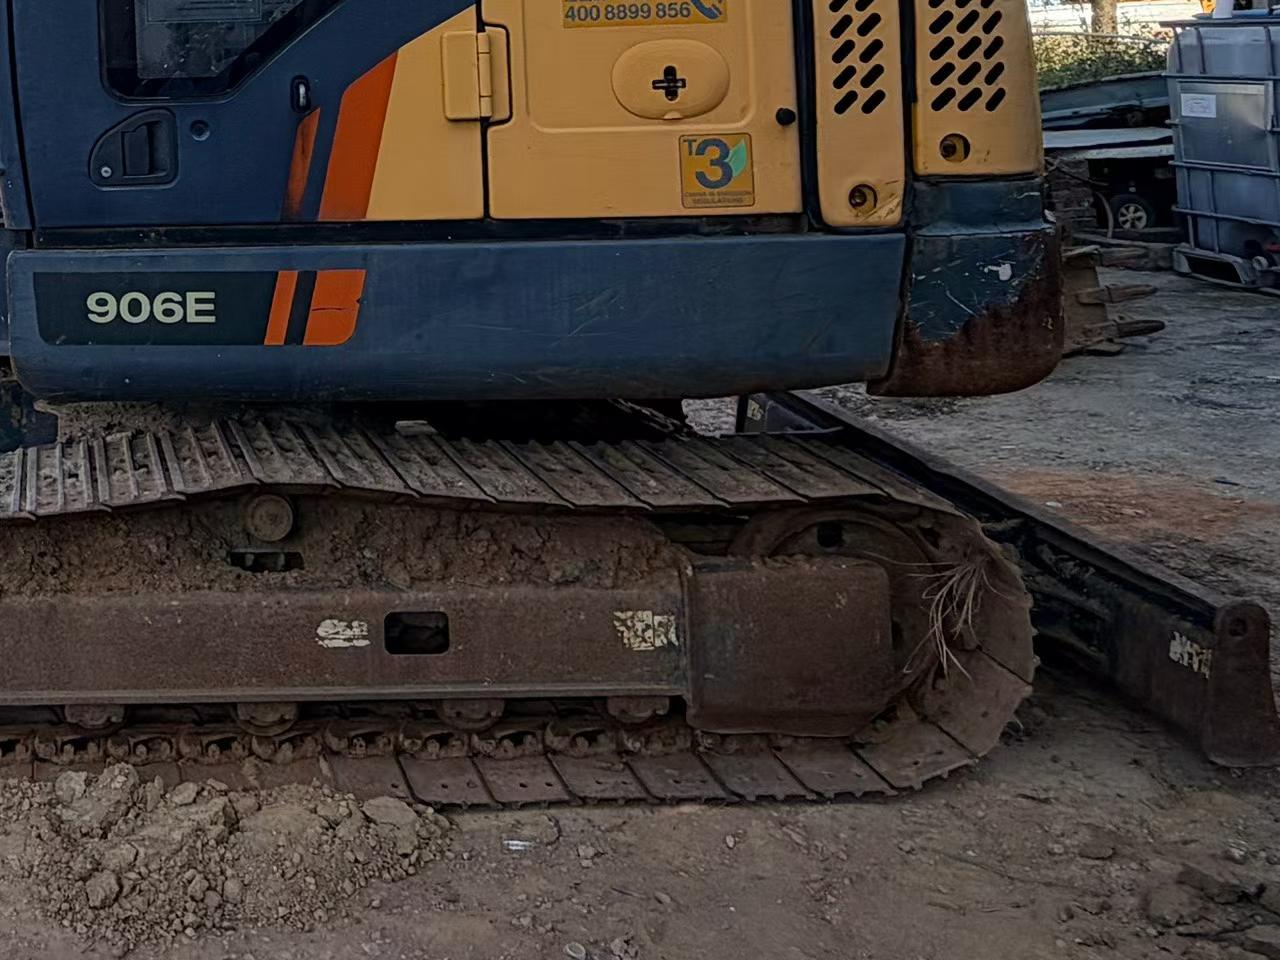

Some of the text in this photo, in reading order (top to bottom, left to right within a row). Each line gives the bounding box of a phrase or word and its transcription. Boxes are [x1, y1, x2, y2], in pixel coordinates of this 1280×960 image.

[564, 1, 691, 22] 400 8899 856
[86, 291, 216, 324] 906E
